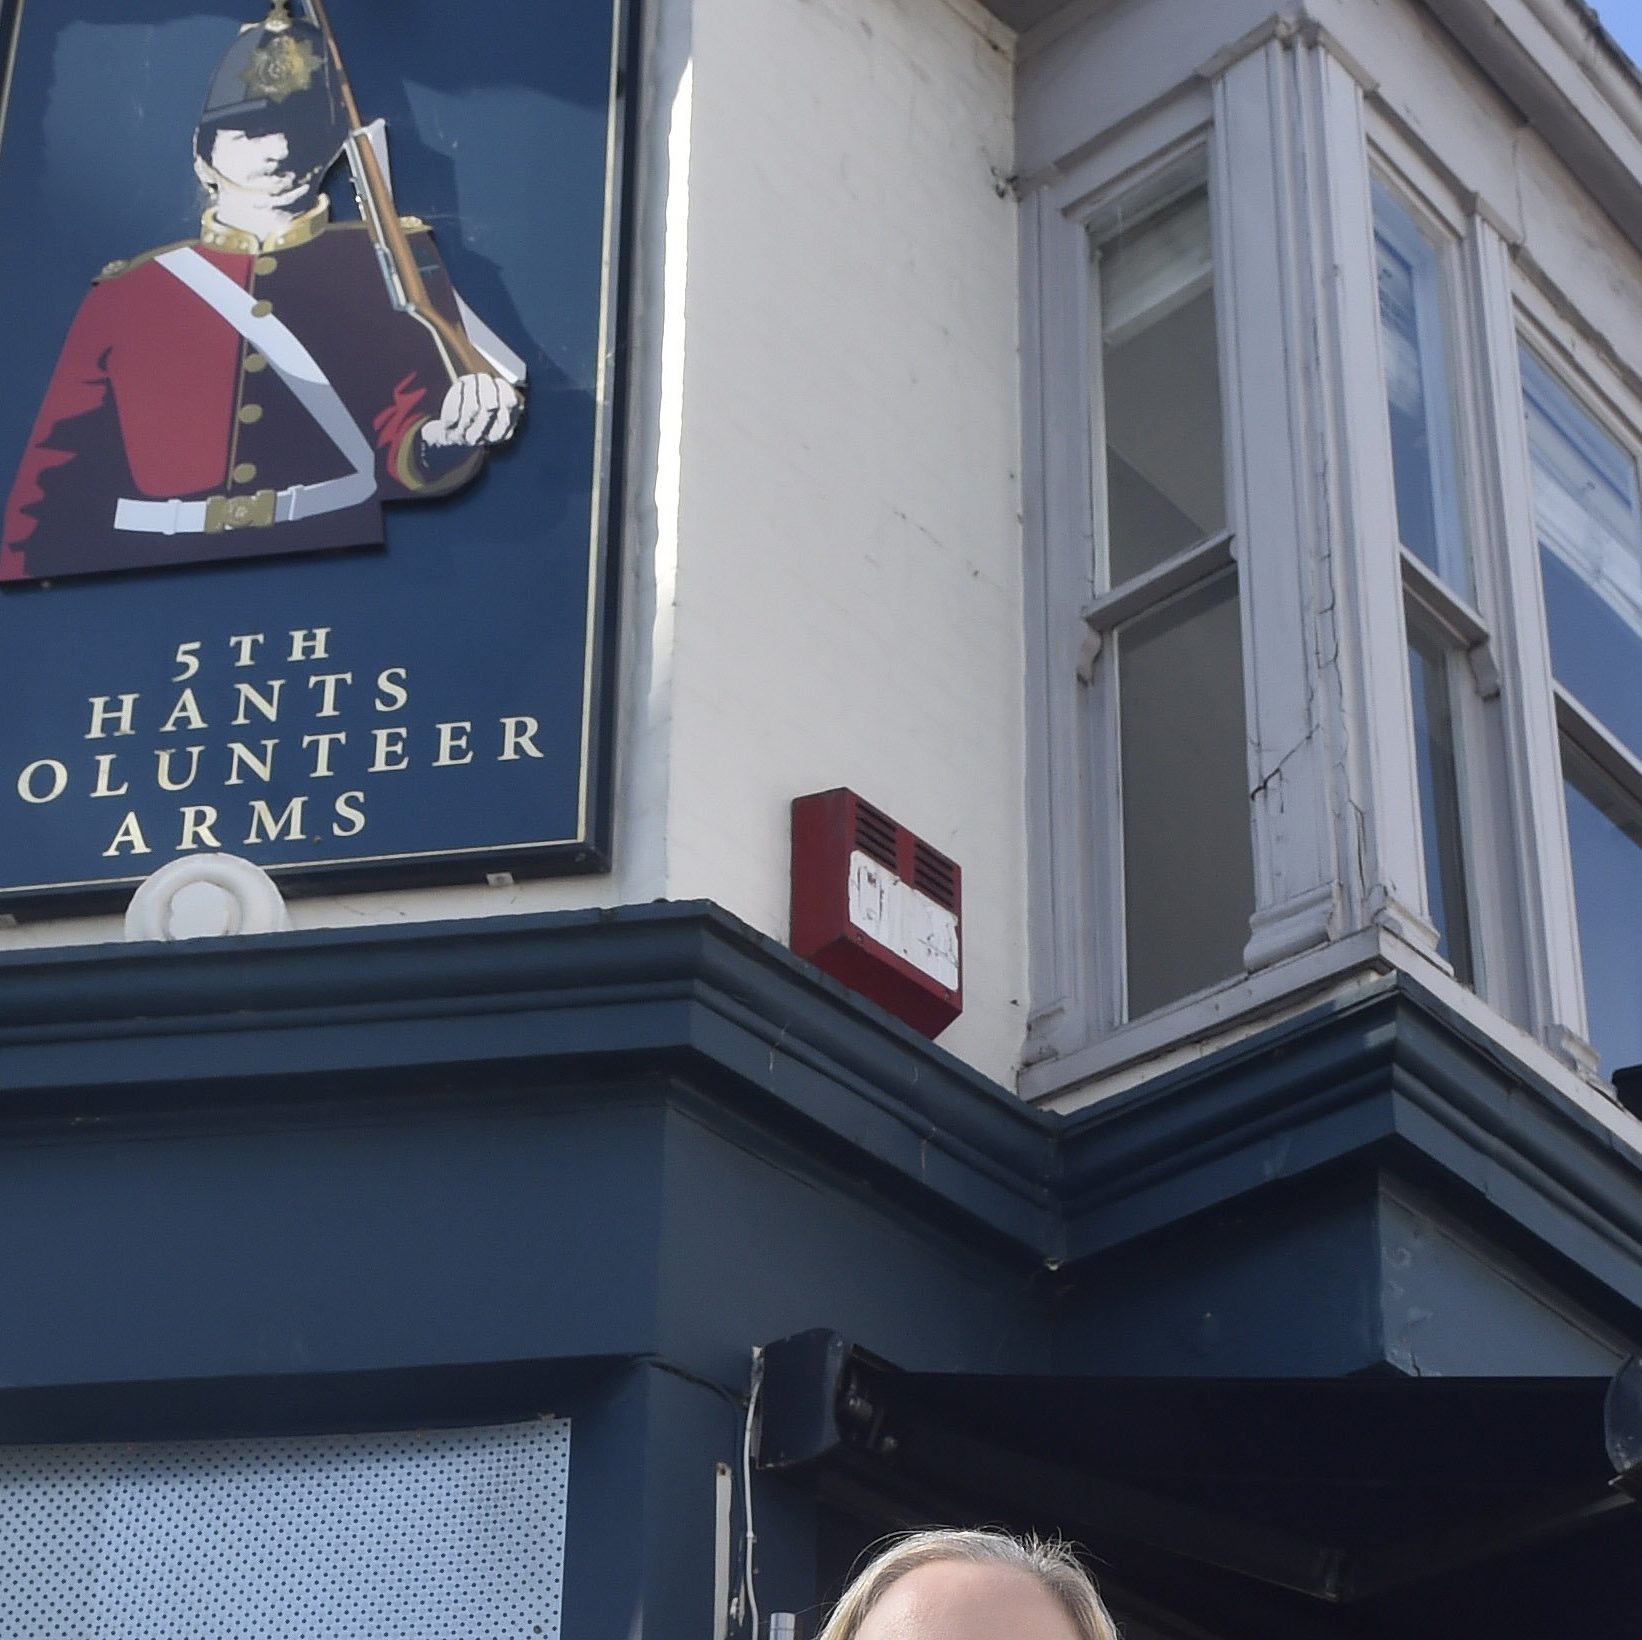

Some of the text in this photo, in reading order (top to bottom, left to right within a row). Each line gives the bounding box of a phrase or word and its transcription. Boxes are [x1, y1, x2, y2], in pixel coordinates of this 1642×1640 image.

[172, 627, 331, 682] 5TH
[84, 667, 409, 739] HANTS
[103, 791, 366, 857] ARMS
